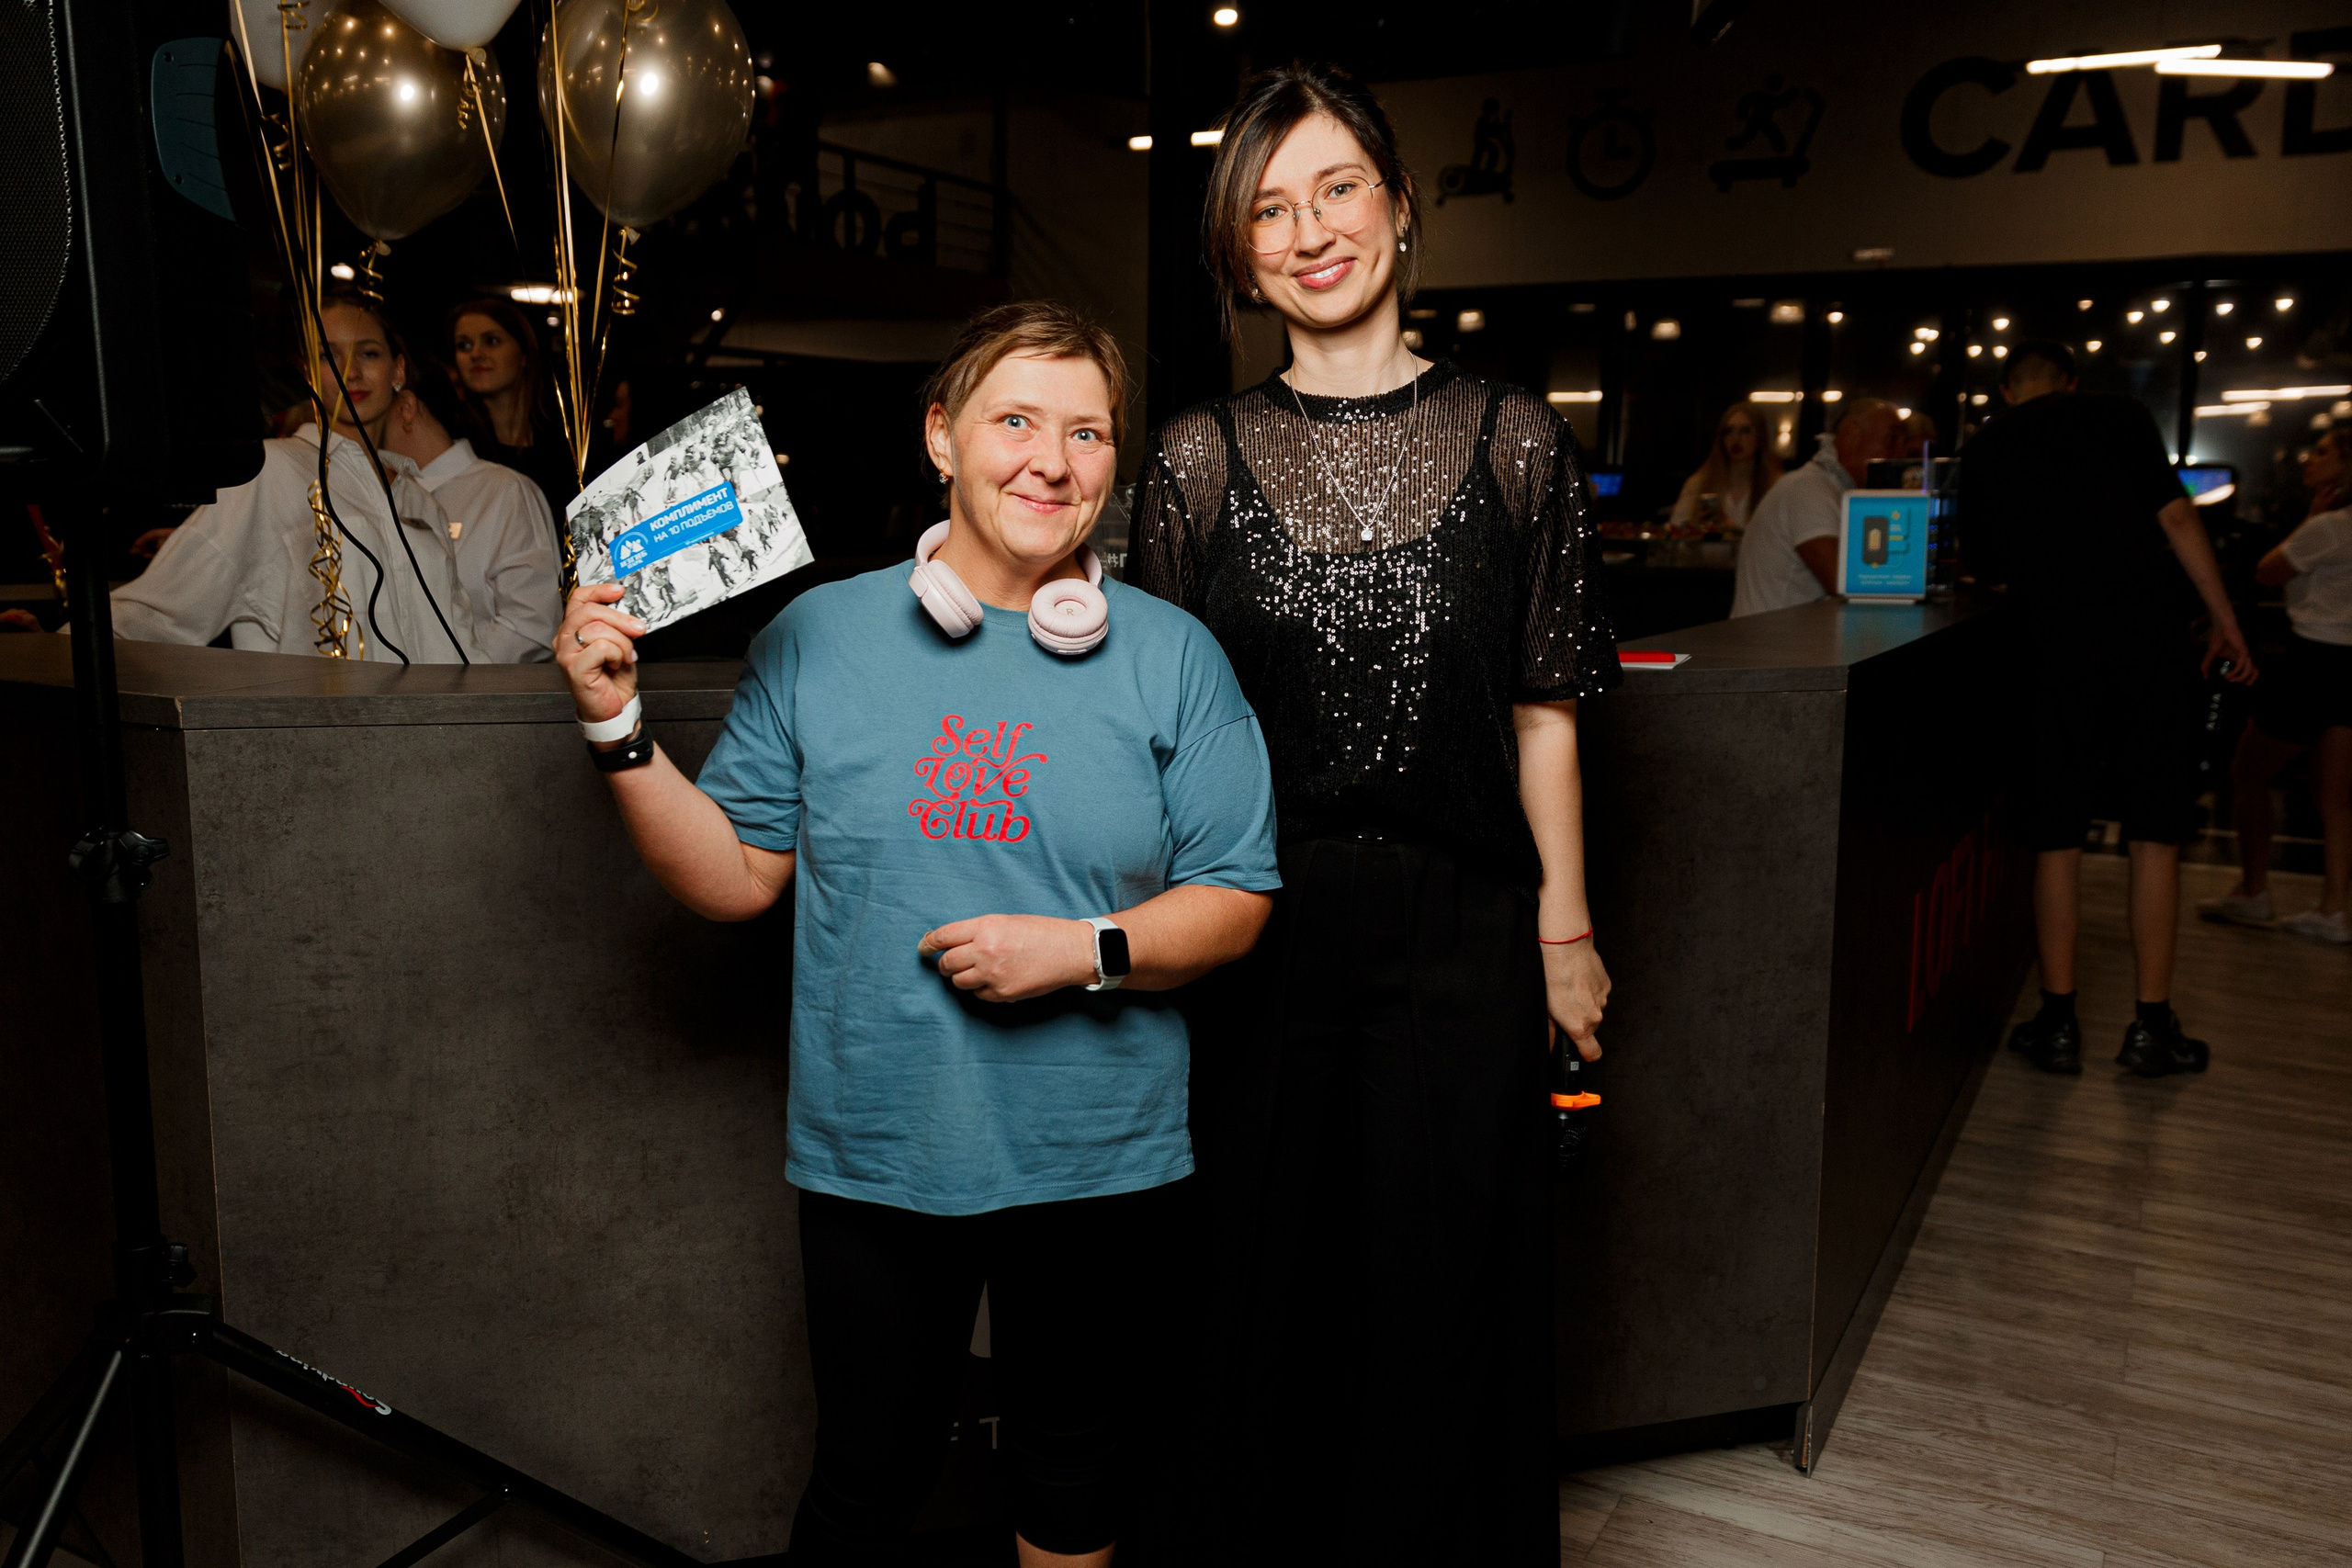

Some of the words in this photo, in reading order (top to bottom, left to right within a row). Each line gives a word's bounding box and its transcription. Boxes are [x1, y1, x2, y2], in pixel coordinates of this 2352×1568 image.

[650, 488, 728, 531] КОМПЛИМЕНТ
[653, 531, 669, 543] НА
[668, 525, 681, 536] 10
[1066, 608, 1075, 616] R
[932, 714, 1034, 769] Self
[913, 753, 1048, 801] Love
[908, 797, 1031, 843] Club
